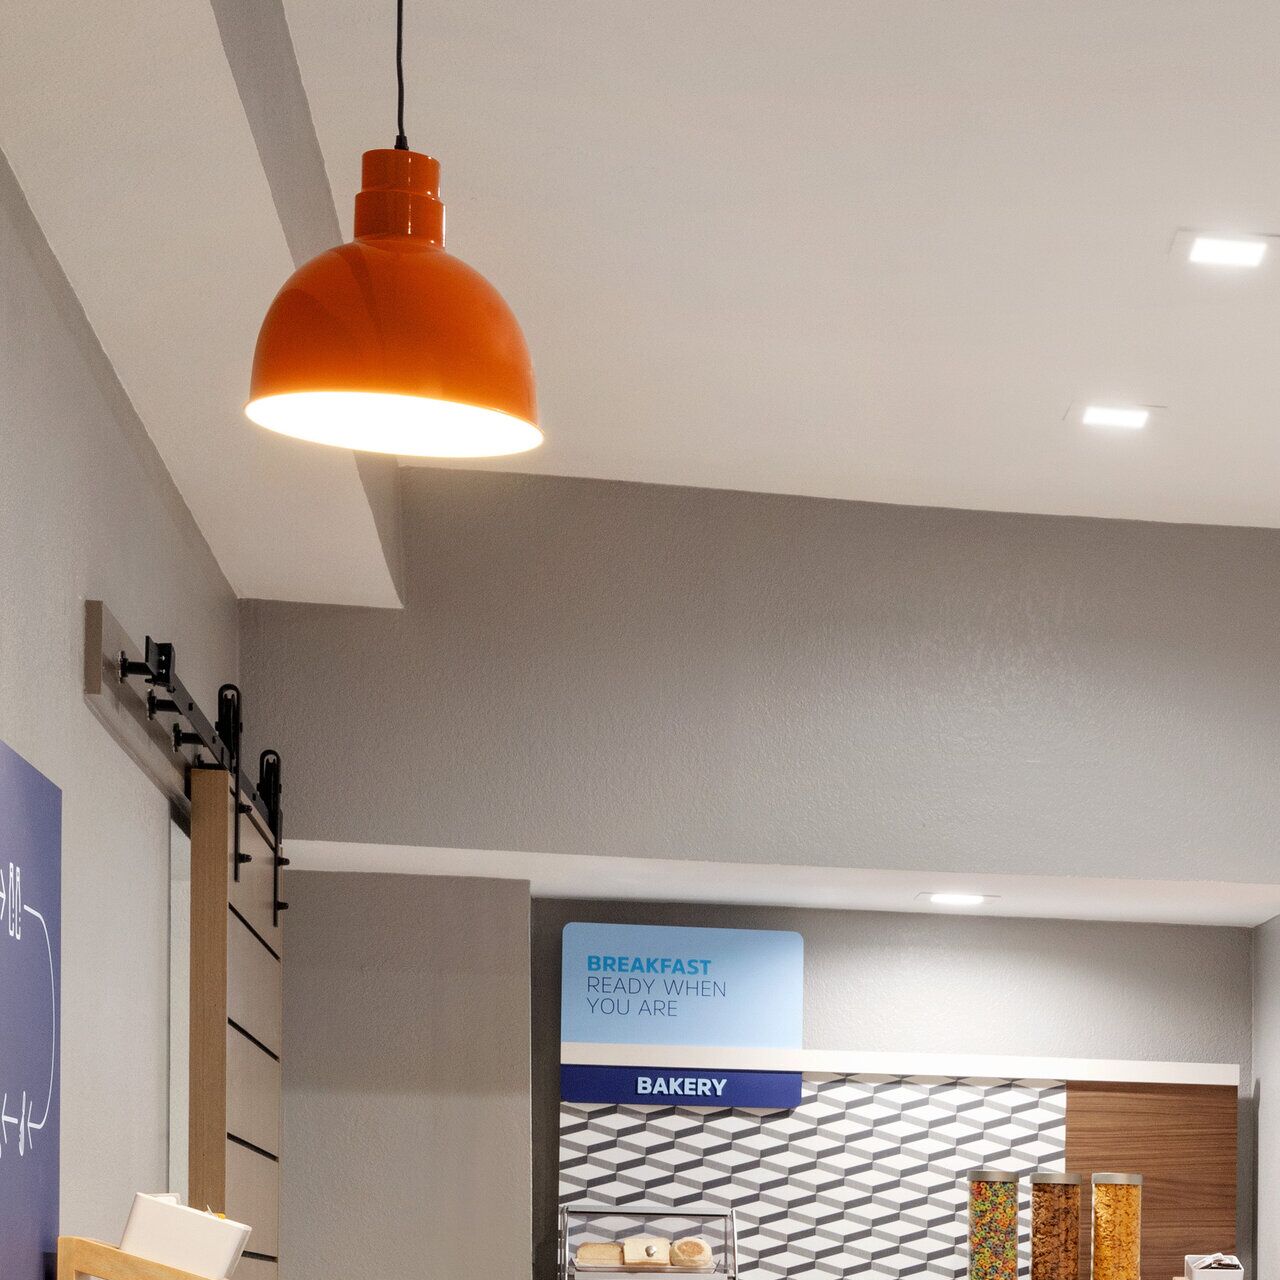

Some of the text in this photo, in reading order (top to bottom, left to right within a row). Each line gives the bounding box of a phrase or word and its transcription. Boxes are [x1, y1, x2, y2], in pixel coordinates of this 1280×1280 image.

[587, 955, 712, 975] BREAKFAST
[587, 976, 727, 998] READY WHEN
[587, 997, 678, 1017] YOU ARE
[636, 1076, 728, 1097] BAKERY
